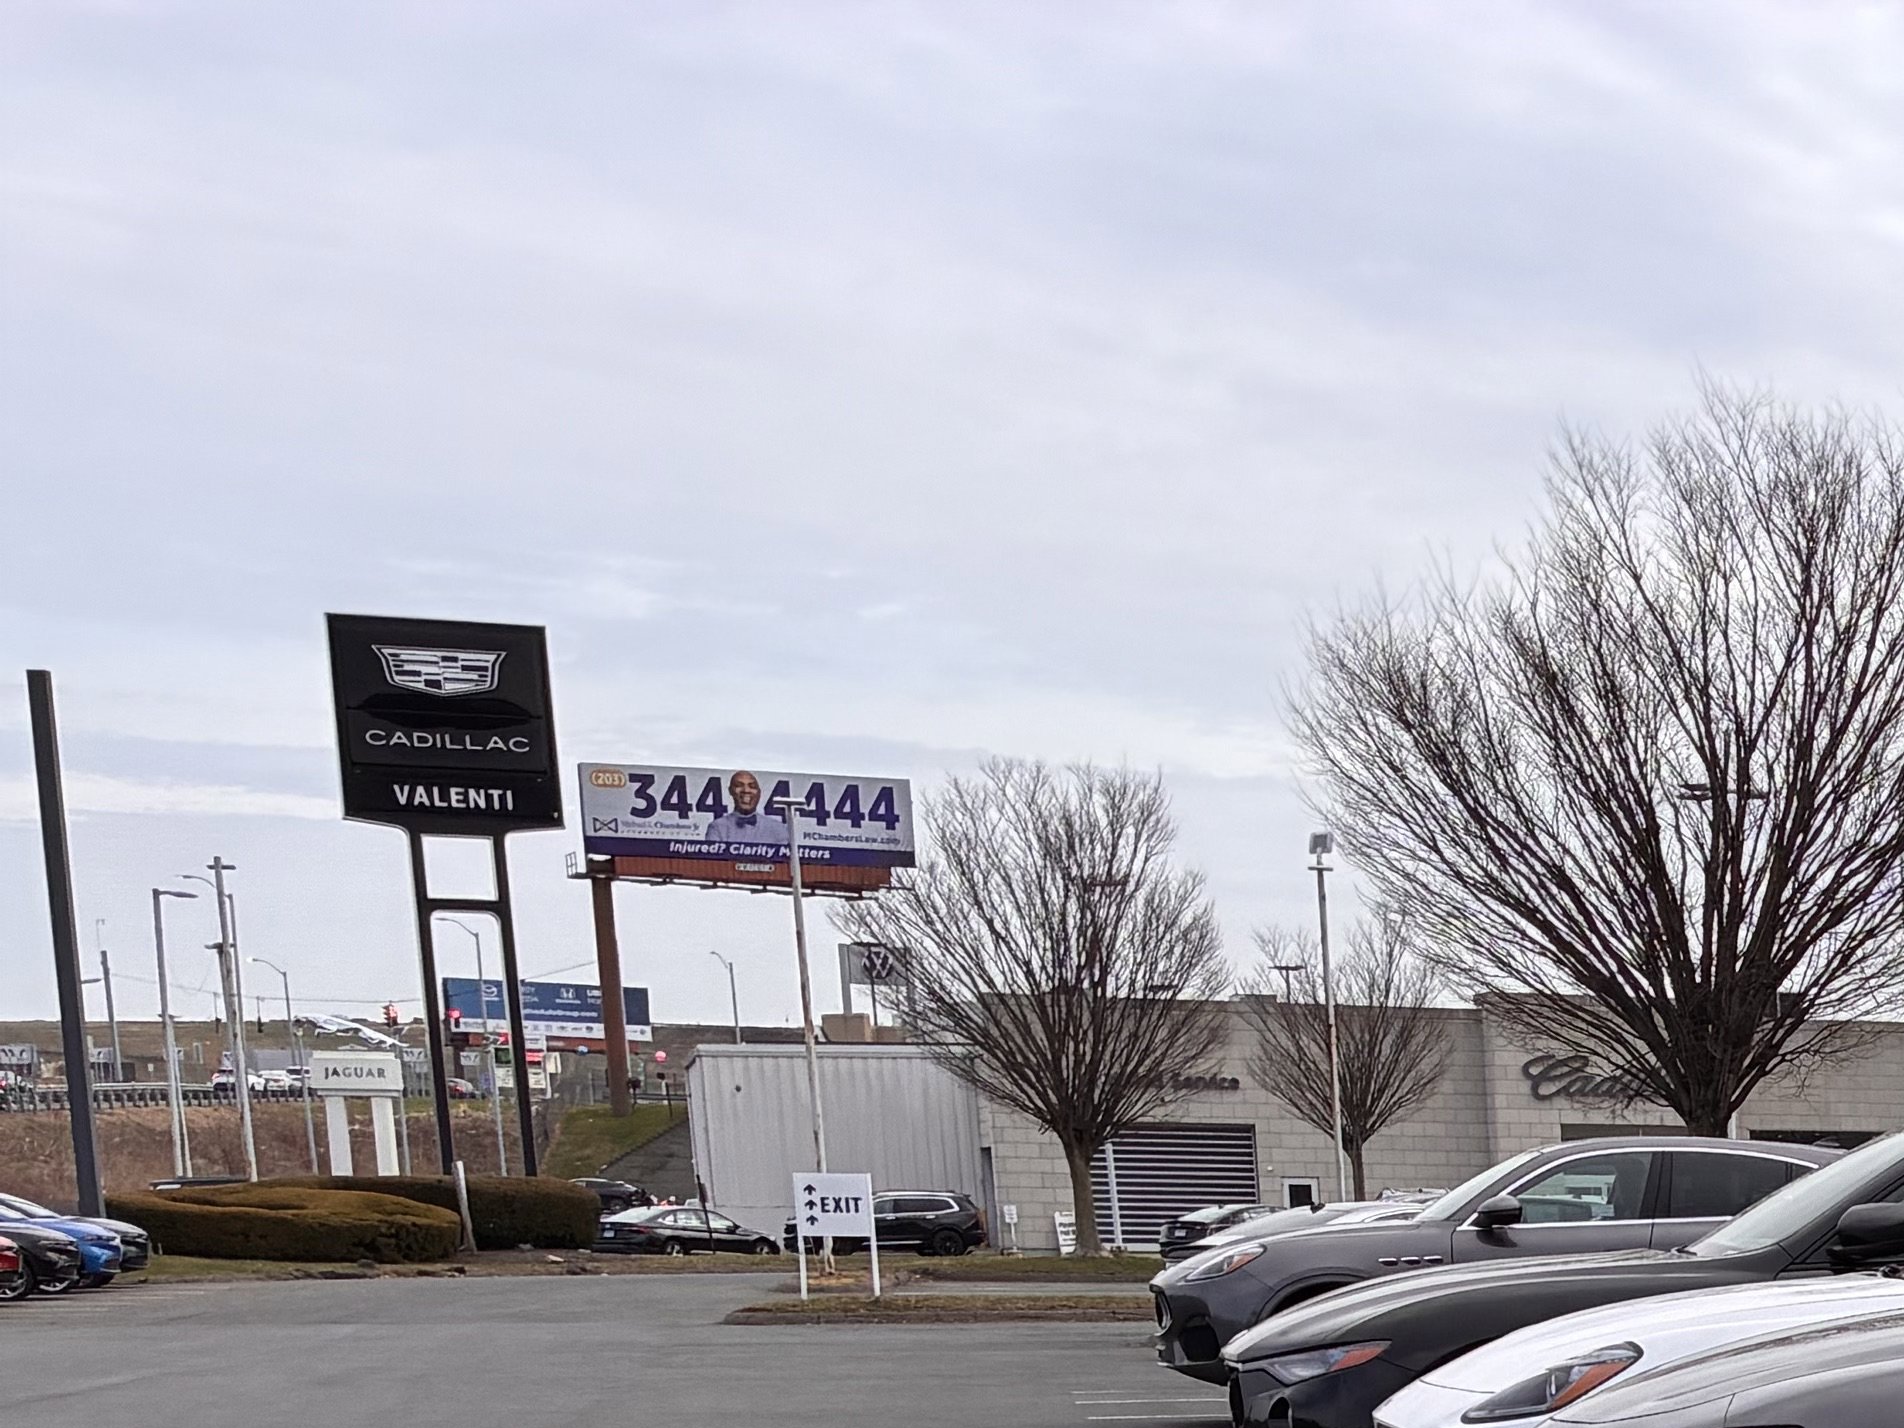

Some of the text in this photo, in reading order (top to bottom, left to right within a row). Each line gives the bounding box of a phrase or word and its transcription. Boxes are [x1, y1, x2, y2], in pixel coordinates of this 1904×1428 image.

[365, 730, 530, 752] CADILLAC
[591, 771, 626, 786] (203)
[393, 784, 514, 811] VALENTI
[669, 841, 831, 858] Injured? Clarity Mtters
[324, 1067, 386, 1080] JAGUAR
[820, 1197, 862, 1214] EXIT
